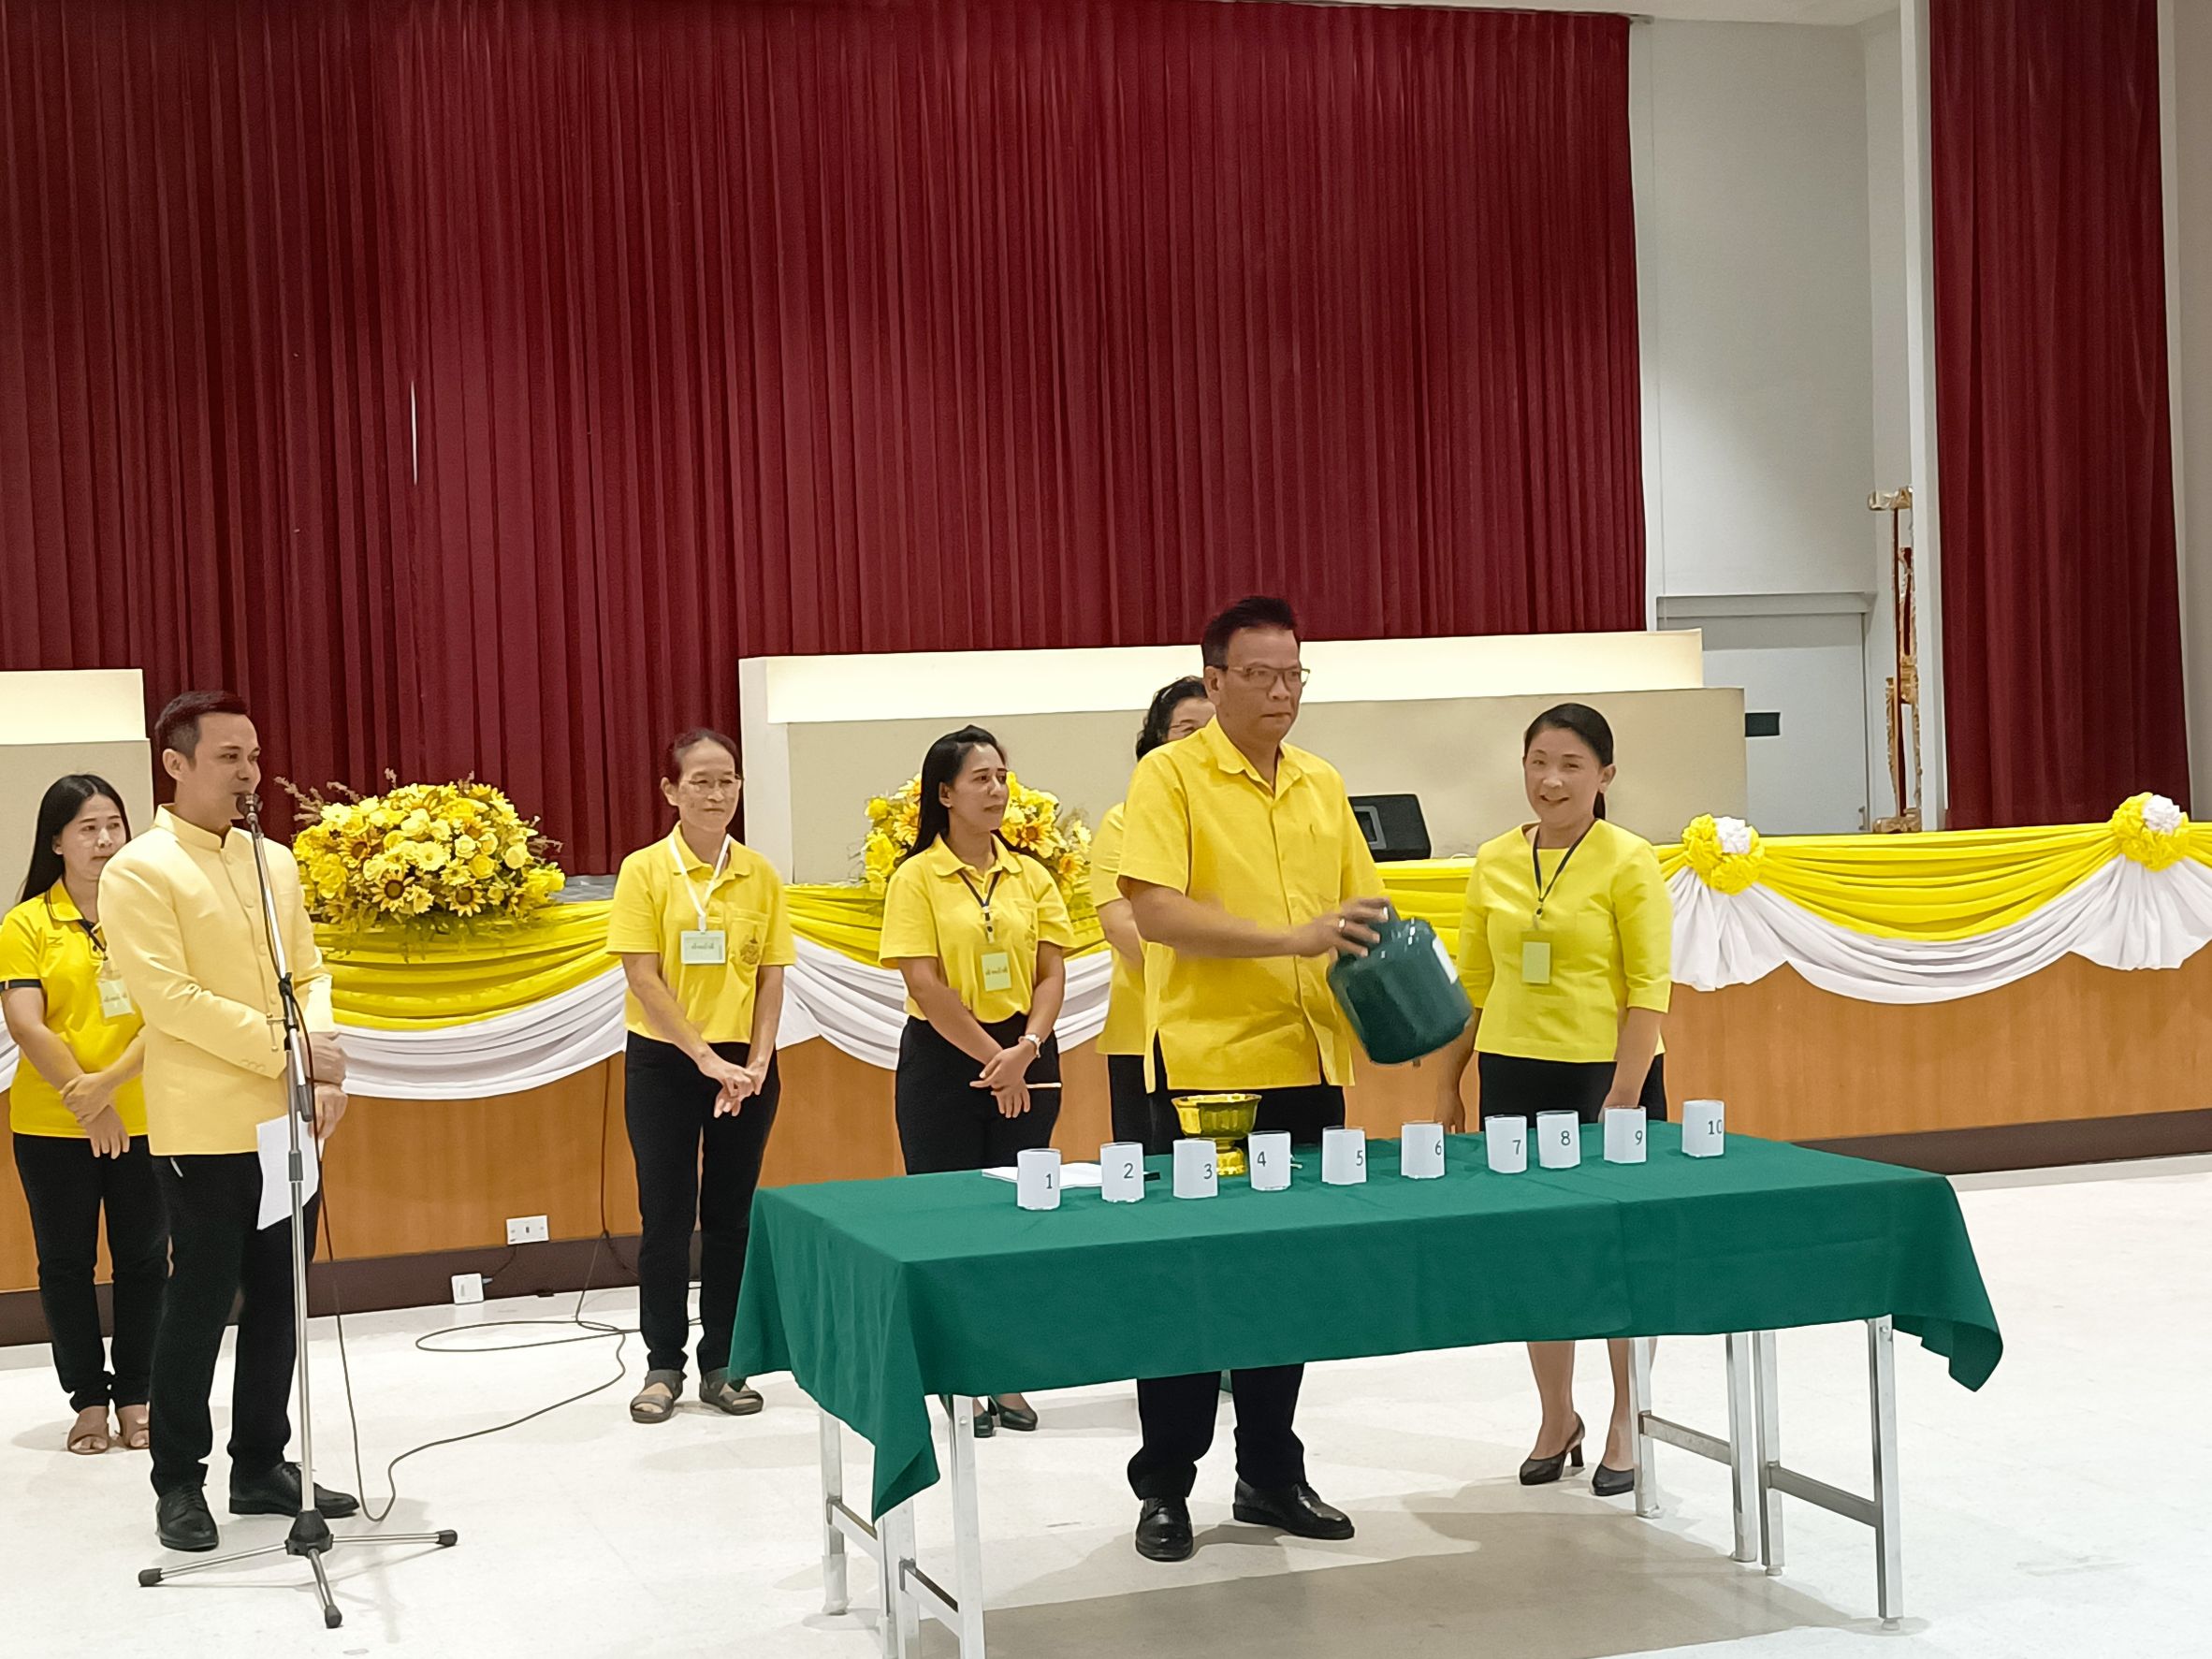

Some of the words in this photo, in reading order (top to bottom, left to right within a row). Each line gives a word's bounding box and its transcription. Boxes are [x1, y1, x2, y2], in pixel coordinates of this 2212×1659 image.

[1708, 1119, 1724, 1135] 10
[1561, 1130, 1571, 1146] 8
[1635, 1129, 1643, 1145] 9
[1434, 1140, 1443, 1156] 6
[1512, 1140, 1521, 1155] 7
[1257, 1151, 1266, 1167] 4
[1356, 1150, 1364, 1166] 5
[1123, 1163, 1134, 1179] 2
[1203, 1163, 1213, 1179] 3
[1045, 1173, 1053, 1189] 1
